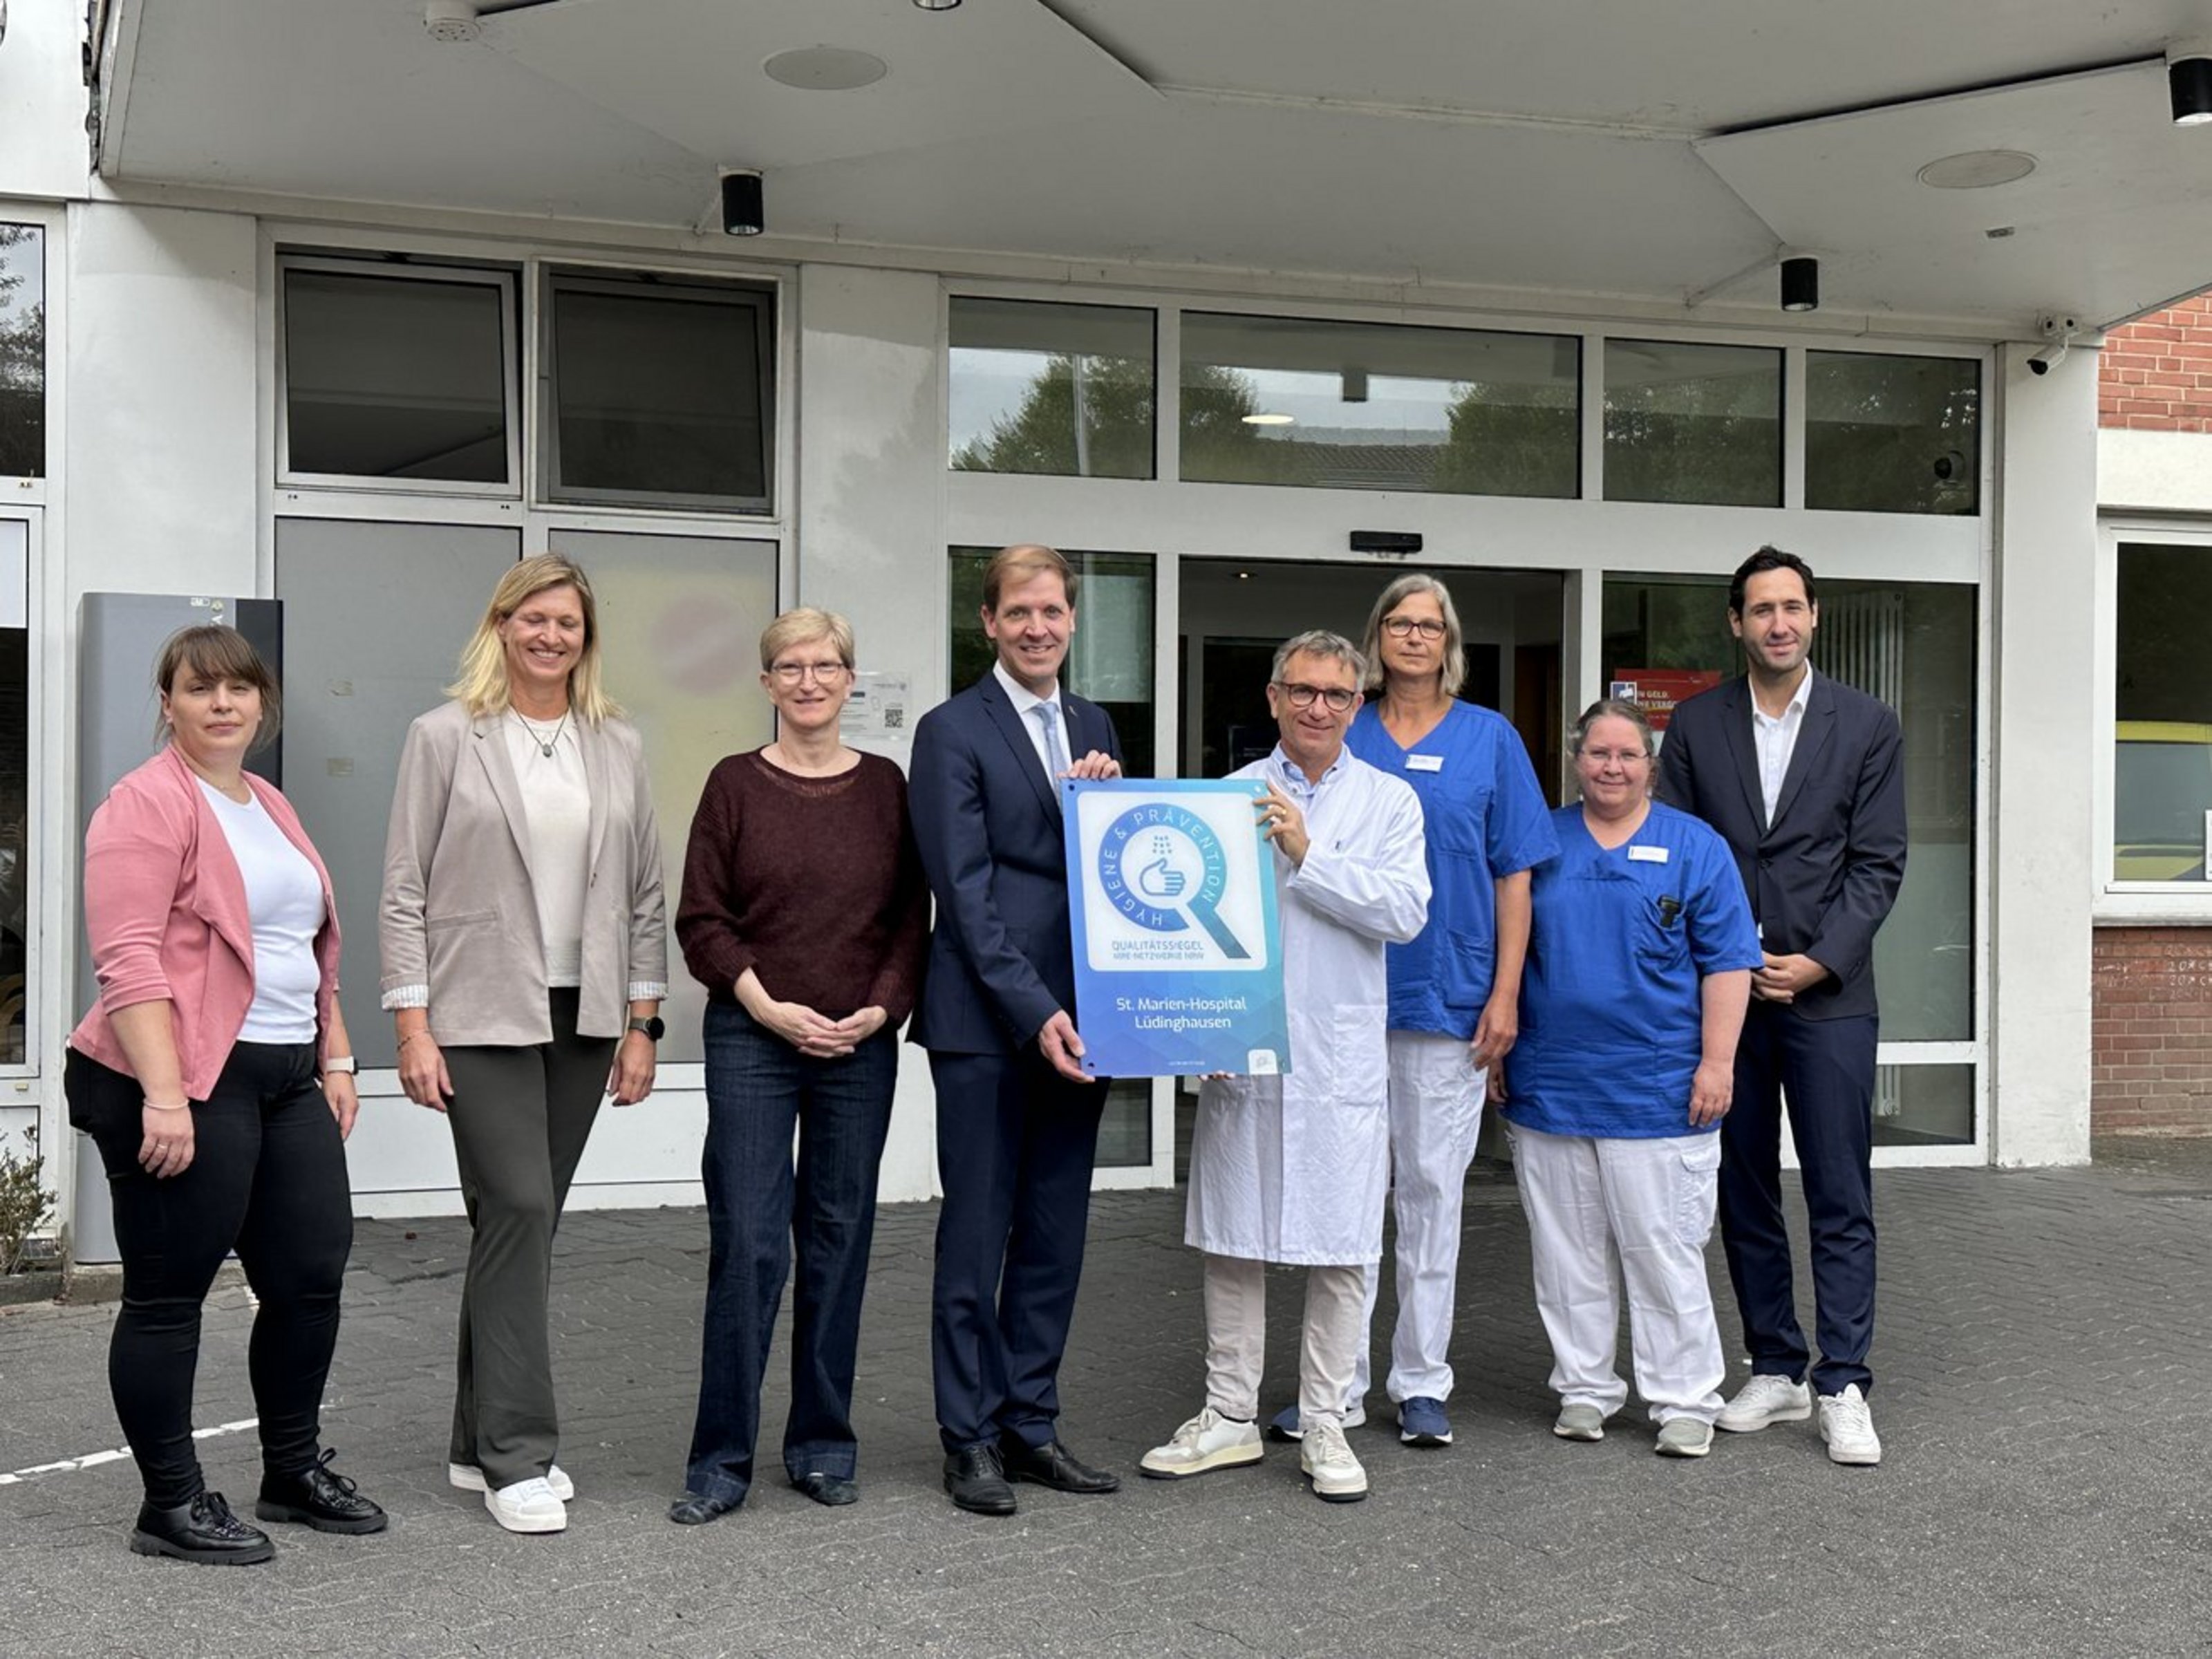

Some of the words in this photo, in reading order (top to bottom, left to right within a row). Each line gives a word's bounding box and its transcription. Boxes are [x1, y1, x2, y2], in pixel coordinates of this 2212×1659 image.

[1114, 827, 1128, 840] &
[1133, 807, 1221, 903] PRÄVENTION
[1104, 849, 1162, 926] HYGIENE
[1112, 940, 1204, 950] QUALITÄTSSIEGEL
[1116, 997, 1135, 1011] St.
[1138, 996, 1246, 1013] Marien-Hospital
[1135, 1015, 1232, 1032] Lüdinghausen
